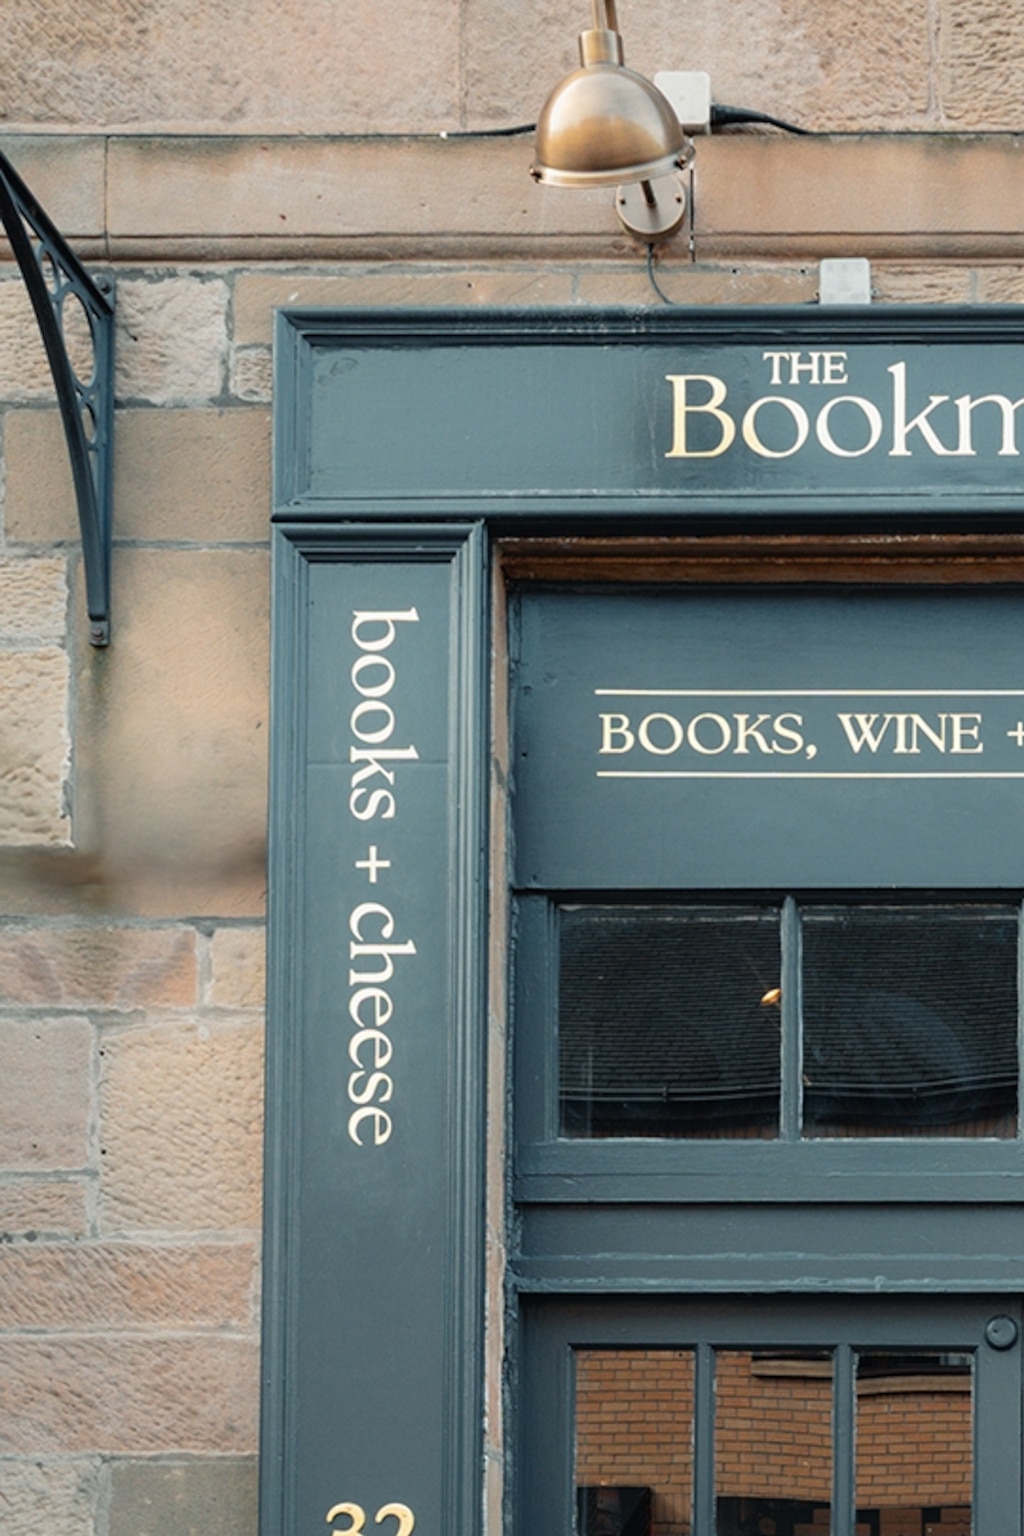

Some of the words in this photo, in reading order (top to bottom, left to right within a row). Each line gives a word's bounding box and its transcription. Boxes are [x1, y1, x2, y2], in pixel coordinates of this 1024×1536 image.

[762, 351, 849, 385] THE
[349, 607, 420, 821] books
[598, 712, 817, 760] BOOKS,
[837, 713, 984, 754] WINE
[355, 845, 391, 884] +
[347, 902, 417, 1146] cheese
